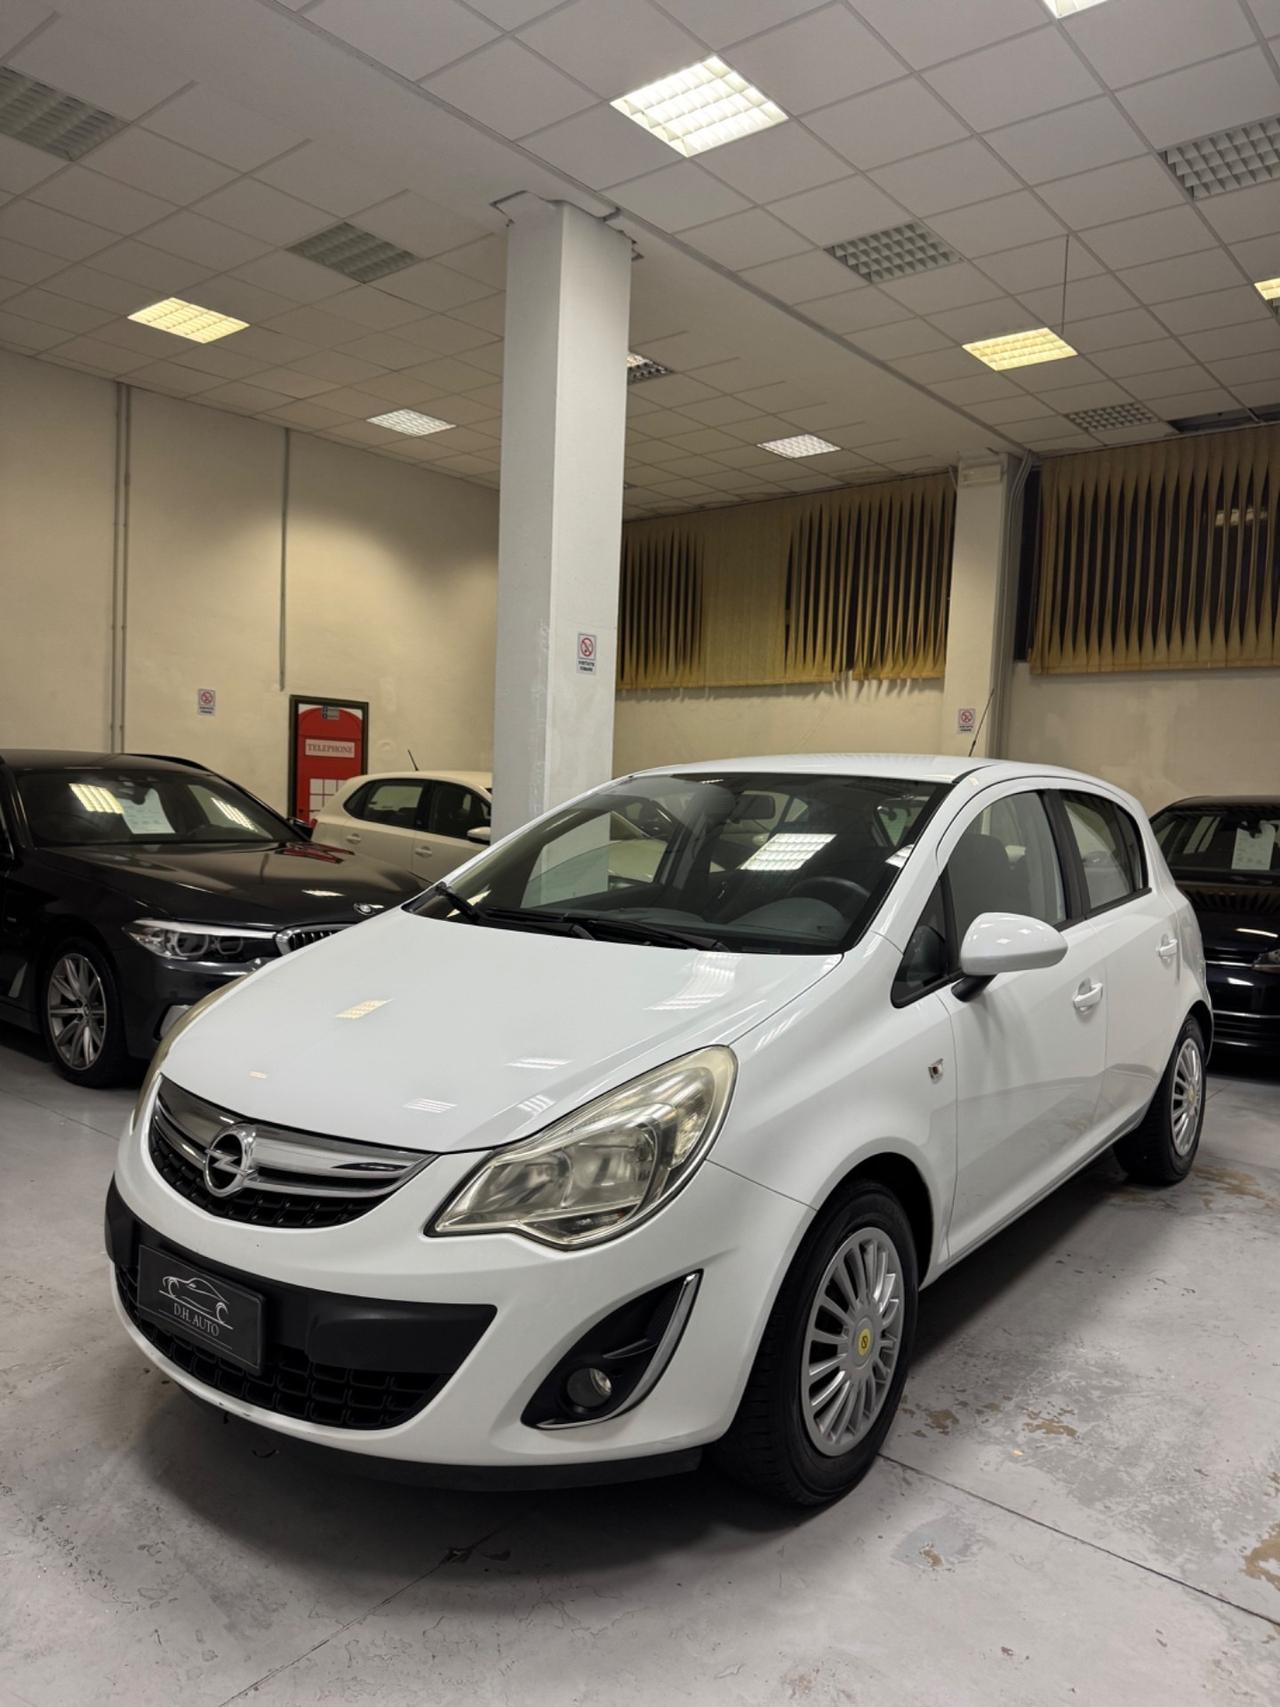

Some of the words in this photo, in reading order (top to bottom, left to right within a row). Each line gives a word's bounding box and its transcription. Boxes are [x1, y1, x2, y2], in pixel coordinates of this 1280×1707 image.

[307, 743, 353, 754] TELEPHONE
[173, 1302, 192, 1322] D.H.
[192, 1315, 220, 1337] AUTO
